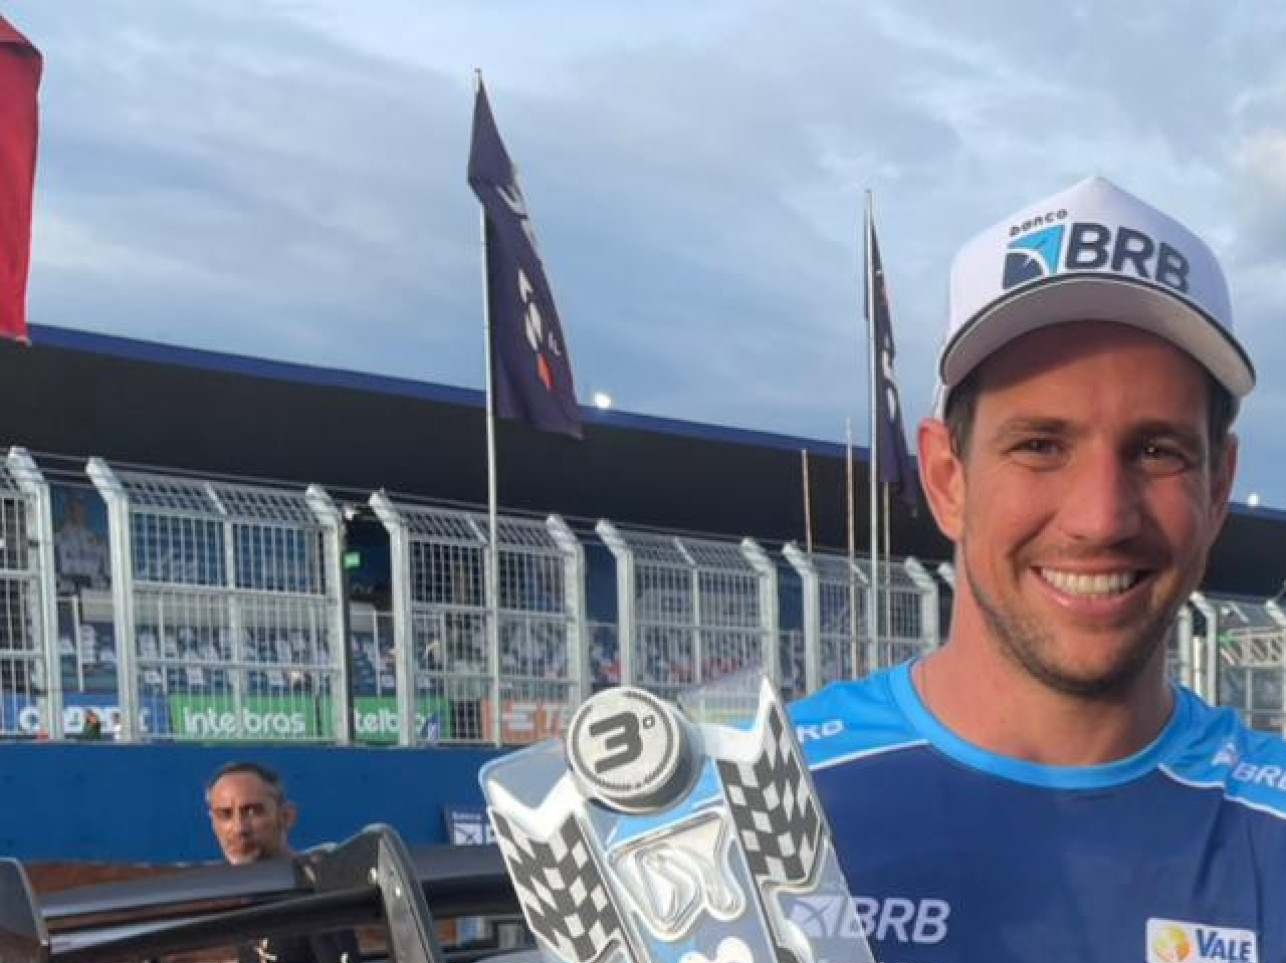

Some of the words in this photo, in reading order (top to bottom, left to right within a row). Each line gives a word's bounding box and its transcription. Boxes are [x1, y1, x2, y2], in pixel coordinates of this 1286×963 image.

[1009, 208, 1068, 236] banco
[1065, 222, 1191, 294] BRB
[840, 896, 951, 944] BRB
[1195, 927, 1254, 961] VALE
